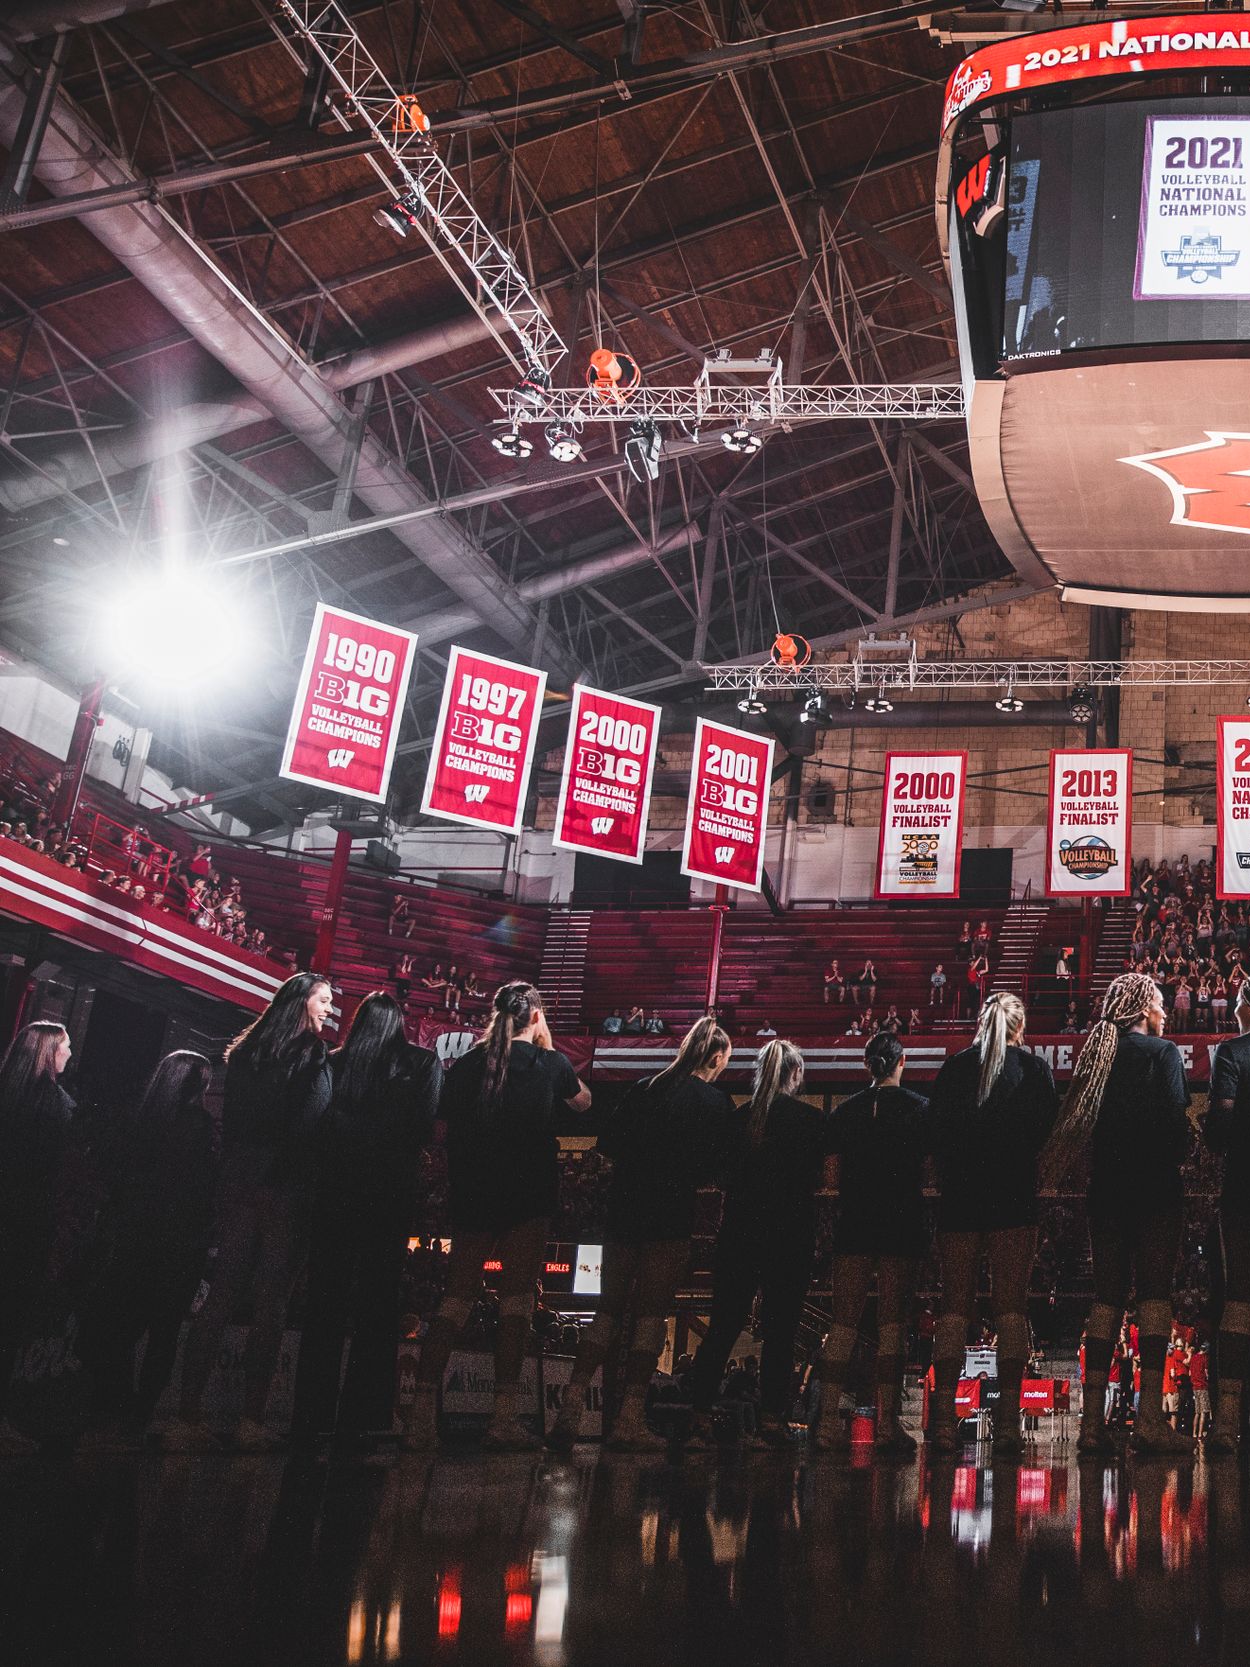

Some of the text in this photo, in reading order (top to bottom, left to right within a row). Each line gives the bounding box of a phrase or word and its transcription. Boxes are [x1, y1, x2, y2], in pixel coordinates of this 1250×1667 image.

[1024, 43, 1090, 71] 2021
[1165, 136, 1243, 169] 2021
[1162, 174, 1246, 185] VOLLEYBALL
[1160, 188, 1246, 201] NATIONAL
[1160, 204, 1246, 216] CHAMPIONS
[1008, 350, 1061, 360] DAKTRONICS
[323, 632, 396, 684] 1990
[458, 674, 527, 720] 1997
[311, 704, 384, 734] VOLLEYBALL
[308, 718, 381, 748] CHAMPIONS
[580, 710, 646, 756] 2000
[449, 742, 516, 768] VOLLEYBALL
[705, 744, 758, 786] 2001
[445, 754, 515, 782] CHAMPIONS
[575, 776, 637, 802] VOLLEYBALL
[894, 772, 955, 800] 2000
[1062, 770, 1118, 797] 2013
[573, 790, 636, 815] CHAMPIONS
[894, 804, 952, 814] VOLLEYBALL
[1061, 802, 1118, 811] VOLLEYBALL
[698, 820, 754, 844] CHAMPIONS
[700, 808, 754, 832] VOLLEYBALL
[892, 816, 951, 828] FINALIST
[1060, 813, 1118, 826] FINALIST
[1060, 850, 1116, 864] VOLLEYBALL
[1068, 862, 1108, 870] CHAMPIONSHIP
